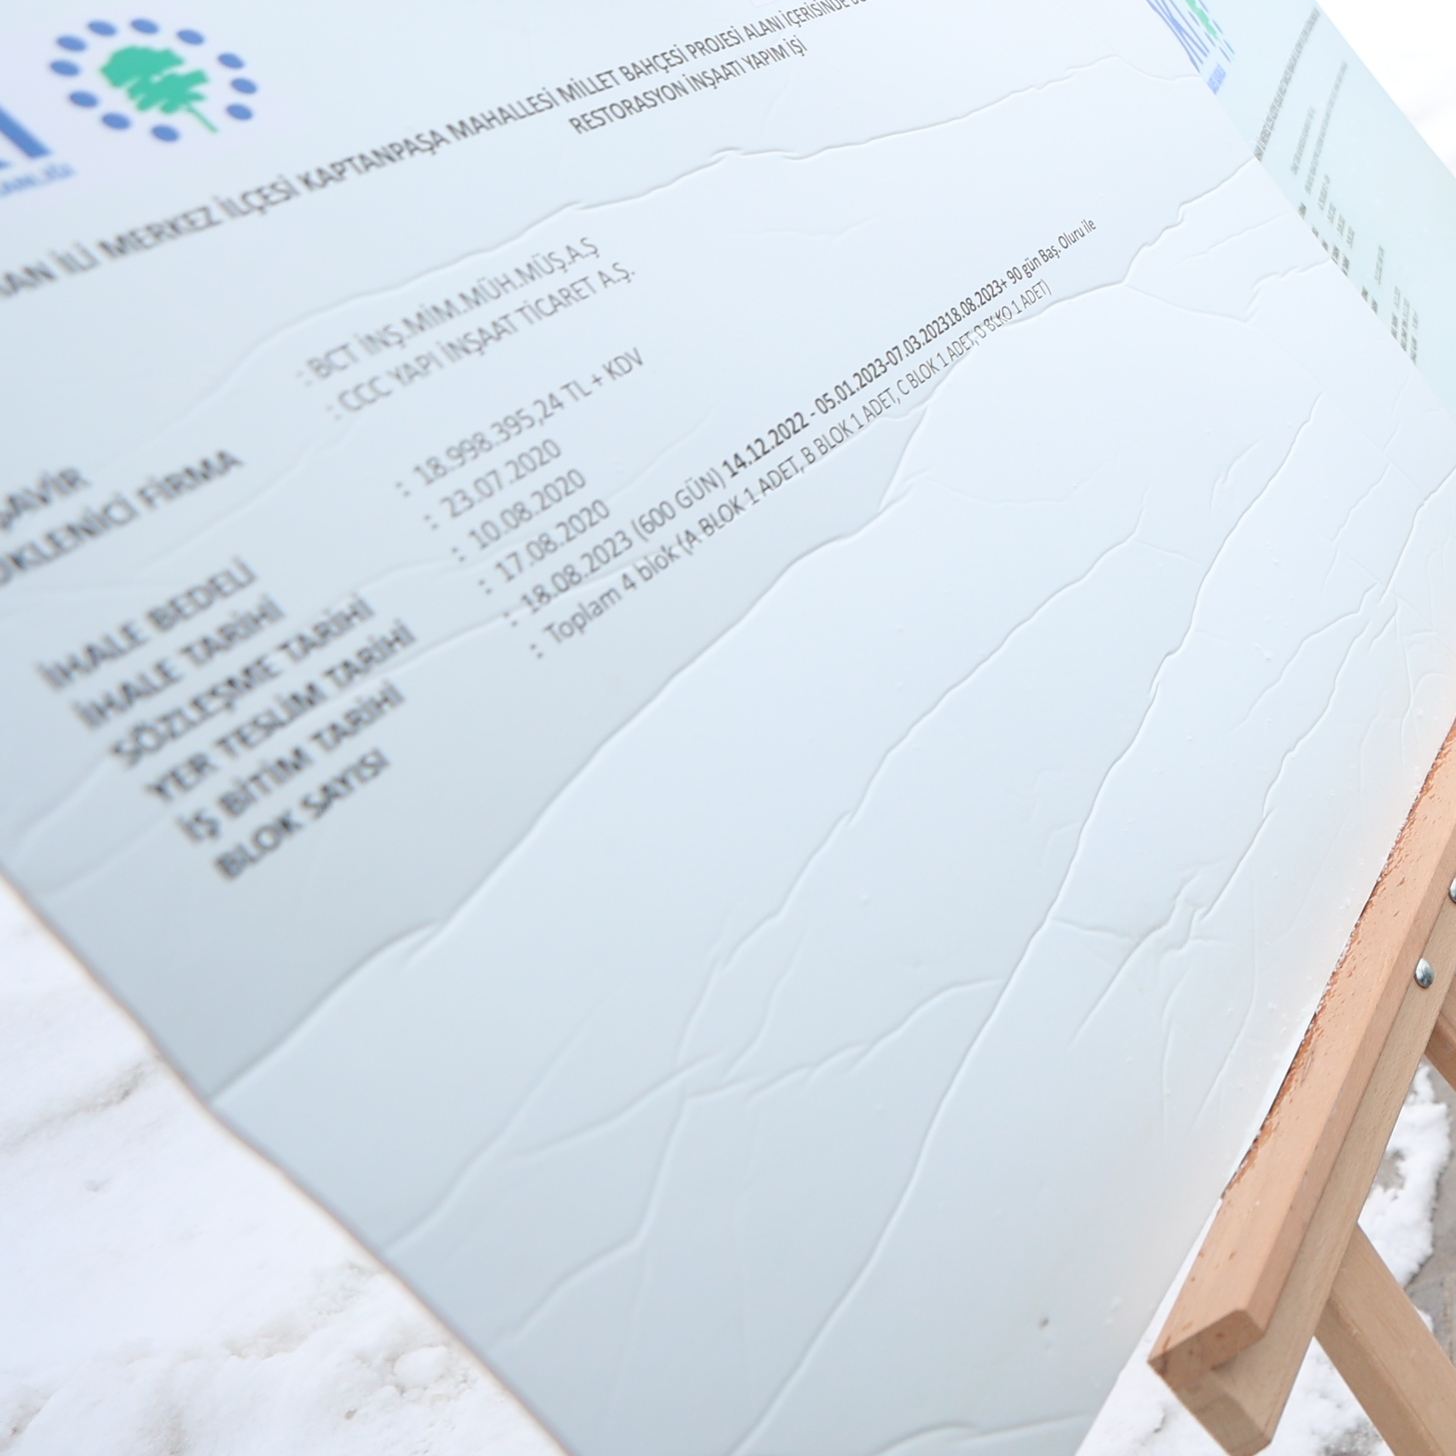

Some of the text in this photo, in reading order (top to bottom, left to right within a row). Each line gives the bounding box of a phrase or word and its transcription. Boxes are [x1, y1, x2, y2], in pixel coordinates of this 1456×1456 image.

[98, 205, 223, 260] MERKEZ
[213, 174, 302, 216] İLÇESİ
[299, 129, 448, 193] KAPTANPAŞA
[446, 86, 559, 141] MAHALLESİ
[556, 70, 622, 105] MİLLET
[618, 44, 690, 83] BAHÇESİ
[685, 26, 746, 60] PROJESİ
[742, 14, 787, 41] ALANI
[568, 34, 808, 135] RESTORASYON İNŞAATI YAPIM İŞİ
[136, 450, 245, 511] FİRMA
[306, 343, 359, 380] BCT
[338, 375, 393, 413] CCC
[388, 349, 444, 387] YAPI
[438, 313, 519, 364] İNŞAAT
[514, 275, 599, 327] TİCARET
[597, 262, 636, 289] A.Ş.
[37, 621, 150, 691] İHALE
[146, 556, 259, 633] BEDELİ
[560, 379, 593, 404] TL
[602, 347, 646, 382] KDV
[73, 657, 185, 731] İHALE
[180, 594, 286, 669] TARİHİ
[440, 438, 563, 520] 23.07.2020
[110, 653, 282, 768] SÖZLEŞME
[279, 592, 376, 664] TARİHİ
[468, 468, 587, 550] 10.08.2020
[146, 752, 218, 804] YER
[214, 683, 327, 758] TESLİM
[323, 619, 417, 690] TARİHİ
[495, 498, 611, 583] 17.08.2020
[214, 810, 303, 882] BLOK
[300, 747, 392, 821] SAYISI
[543, 584, 623, 646] Toplam
[620, 573, 638, 593] 4
[633, 543, 682, 583] blok
[698, 496, 747, 538] BLOK
[743, 487, 760, 507] 1
[800, 445, 817, 465] B
[813, 420, 855, 458] BLOK
[849, 411, 865, 431] 1
[896, 379, 910, 397] C
[906, 357, 941, 390] BLOK
[936, 352, 950, 368] 1
[218, 746, 313, 820] BİTİM
[312, 680, 405, 754] TARİHİ
[521, 529, 633, 614] 18.08.2023
[631, 500, 677, 542] (600
[674, 467, 728, 510] GÜN)
[722, 411, 810, 479] 14.12.2022
[1006, 266, 1023, 286] 90
[1021, 255, 1042, 280] gün
[1057, 227, 1087, 250] Oluru
